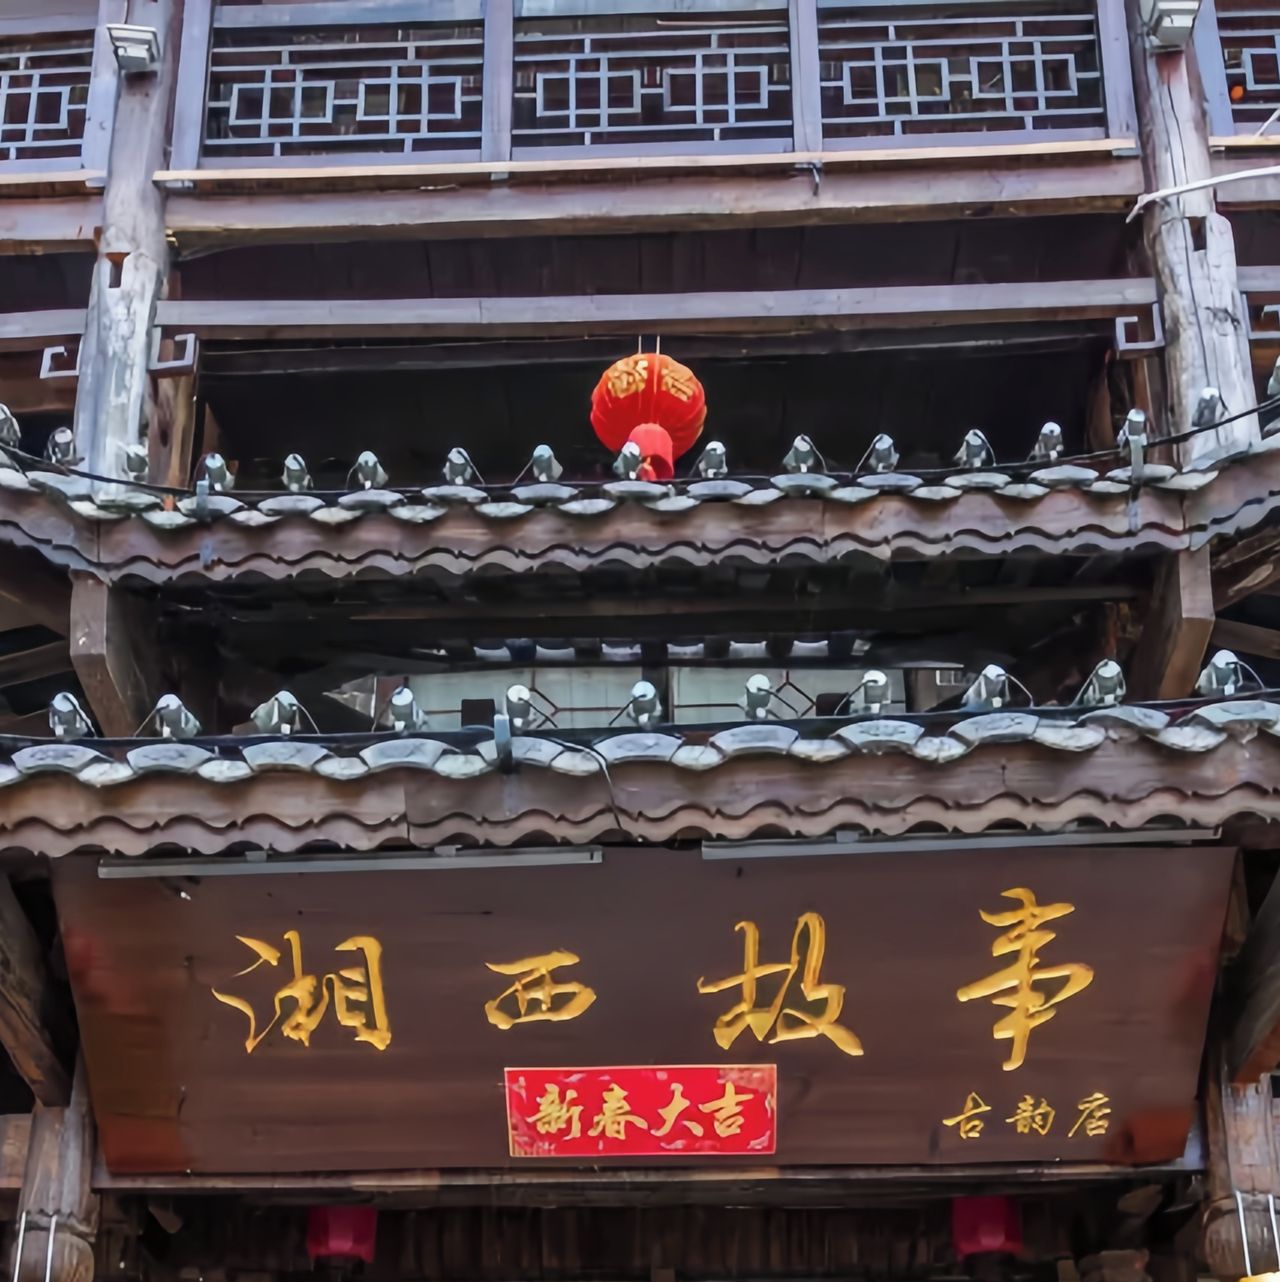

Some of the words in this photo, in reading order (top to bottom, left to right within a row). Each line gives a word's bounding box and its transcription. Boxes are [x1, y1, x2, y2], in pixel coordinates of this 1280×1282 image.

[211, 887, 1094, 1071] 湘西故事
[527, 1081, 755, 1140] 新春大吉
[942, 1092, 1112, 1139] 古韵店
